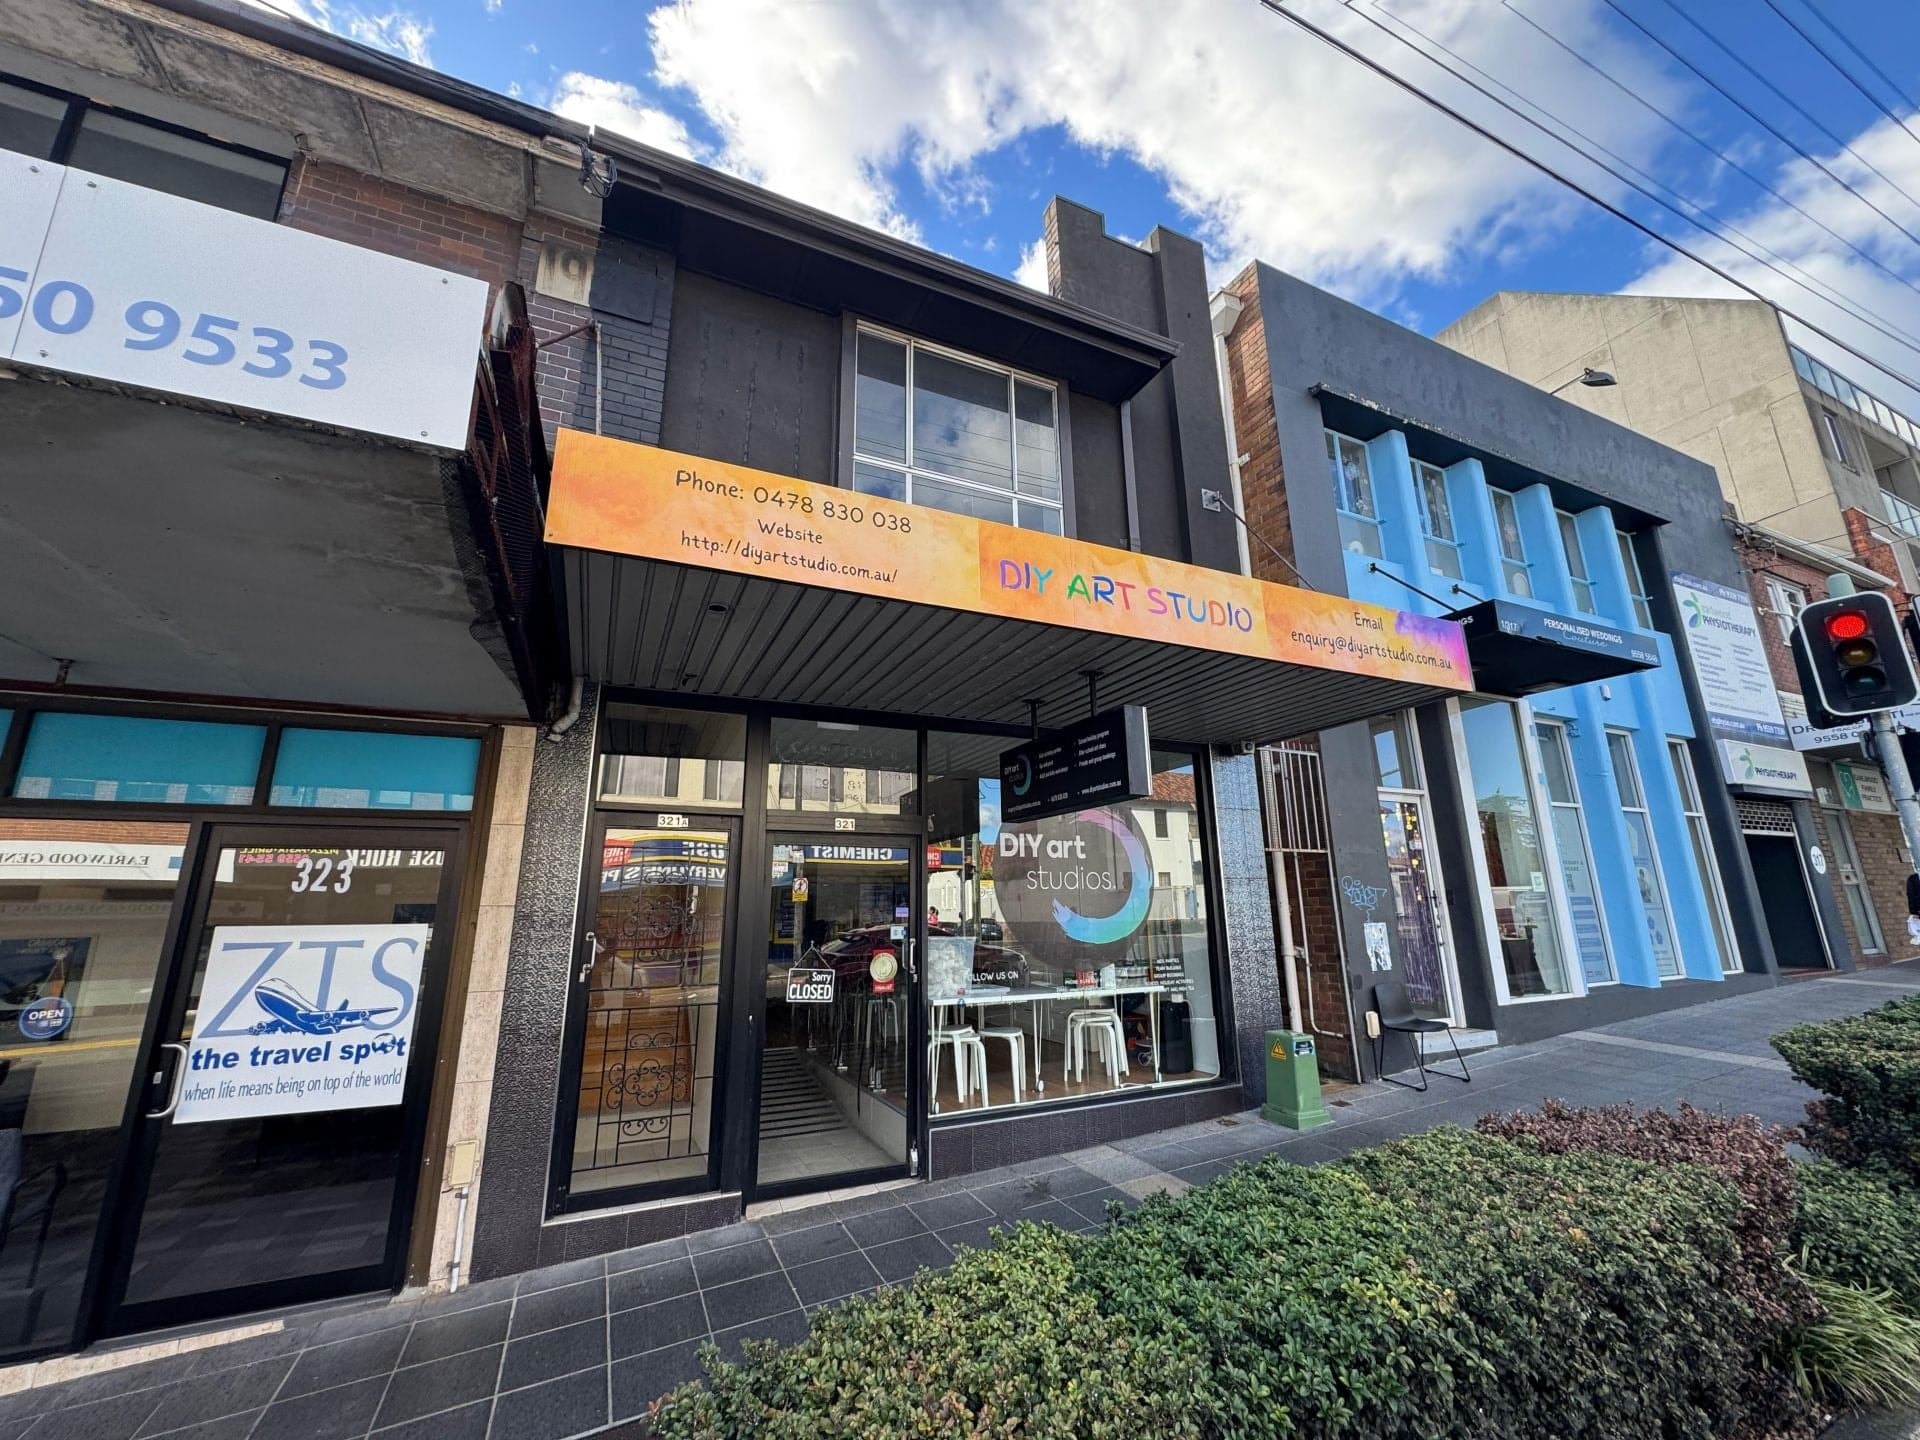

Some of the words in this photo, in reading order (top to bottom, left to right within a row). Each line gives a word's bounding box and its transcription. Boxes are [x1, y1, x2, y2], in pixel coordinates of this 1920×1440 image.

[124, 300, 348, 390] 9533
[676, 470, 744, 500] Phone:
[753, 487, 813, 513] 0478
[823, 501, 864, 523] 830
[872, 512, 912, 533] 038
[757, 519, 823, 544] Website
[682, 531, 898, 583] http://diyartstudio.com.au/
[1000, 560, 1053, 595] DIY
[1067, 574, 1136, 610] ART
[1148, 588, 1253, 632] STUDIO
[1354, 612, 1384, 631] Email
[1544, 618, 1590, 636] PERSONALISED
[1702, 615, 1757, 637] PHYSIOTHERAPY
[1291, 630, 1452, 670] enquiry@diyartstudio.com.au
[836, 819, 855, 830] 321
[1000, 833, 1043, 858] DIY
[1046, 835, 1086, 859] art
[291, 858, 352, 893] 323
[198, 937, 419, 1039] ZTS
[812, 972, 831, 984] Sorry
[965, 972, 993, 982] OLLOW
[996, 972, 1006, 980] US
[1008, 971, 1019, 980] ON
[790, 984, 832, 1000] CLOSED
[29, 1009, 64, 1020] OPEN
[192, 1049, 239, 1070] the
[250, 1041, 331, 1067] travel
[184, 1083, 214, 1101] when
[218, 1080, 235, 1098] life
[238, 1083, 273, 1098] means
[276, 1077, 305, 1097] being
[307, 1078, 321, 1090] on
[323, 1075, 340, 1092] top
[343, 1071, 356, 1087] of
[355, 1070, 372, 1087] the
[373, 1067, 402, 1085] world
